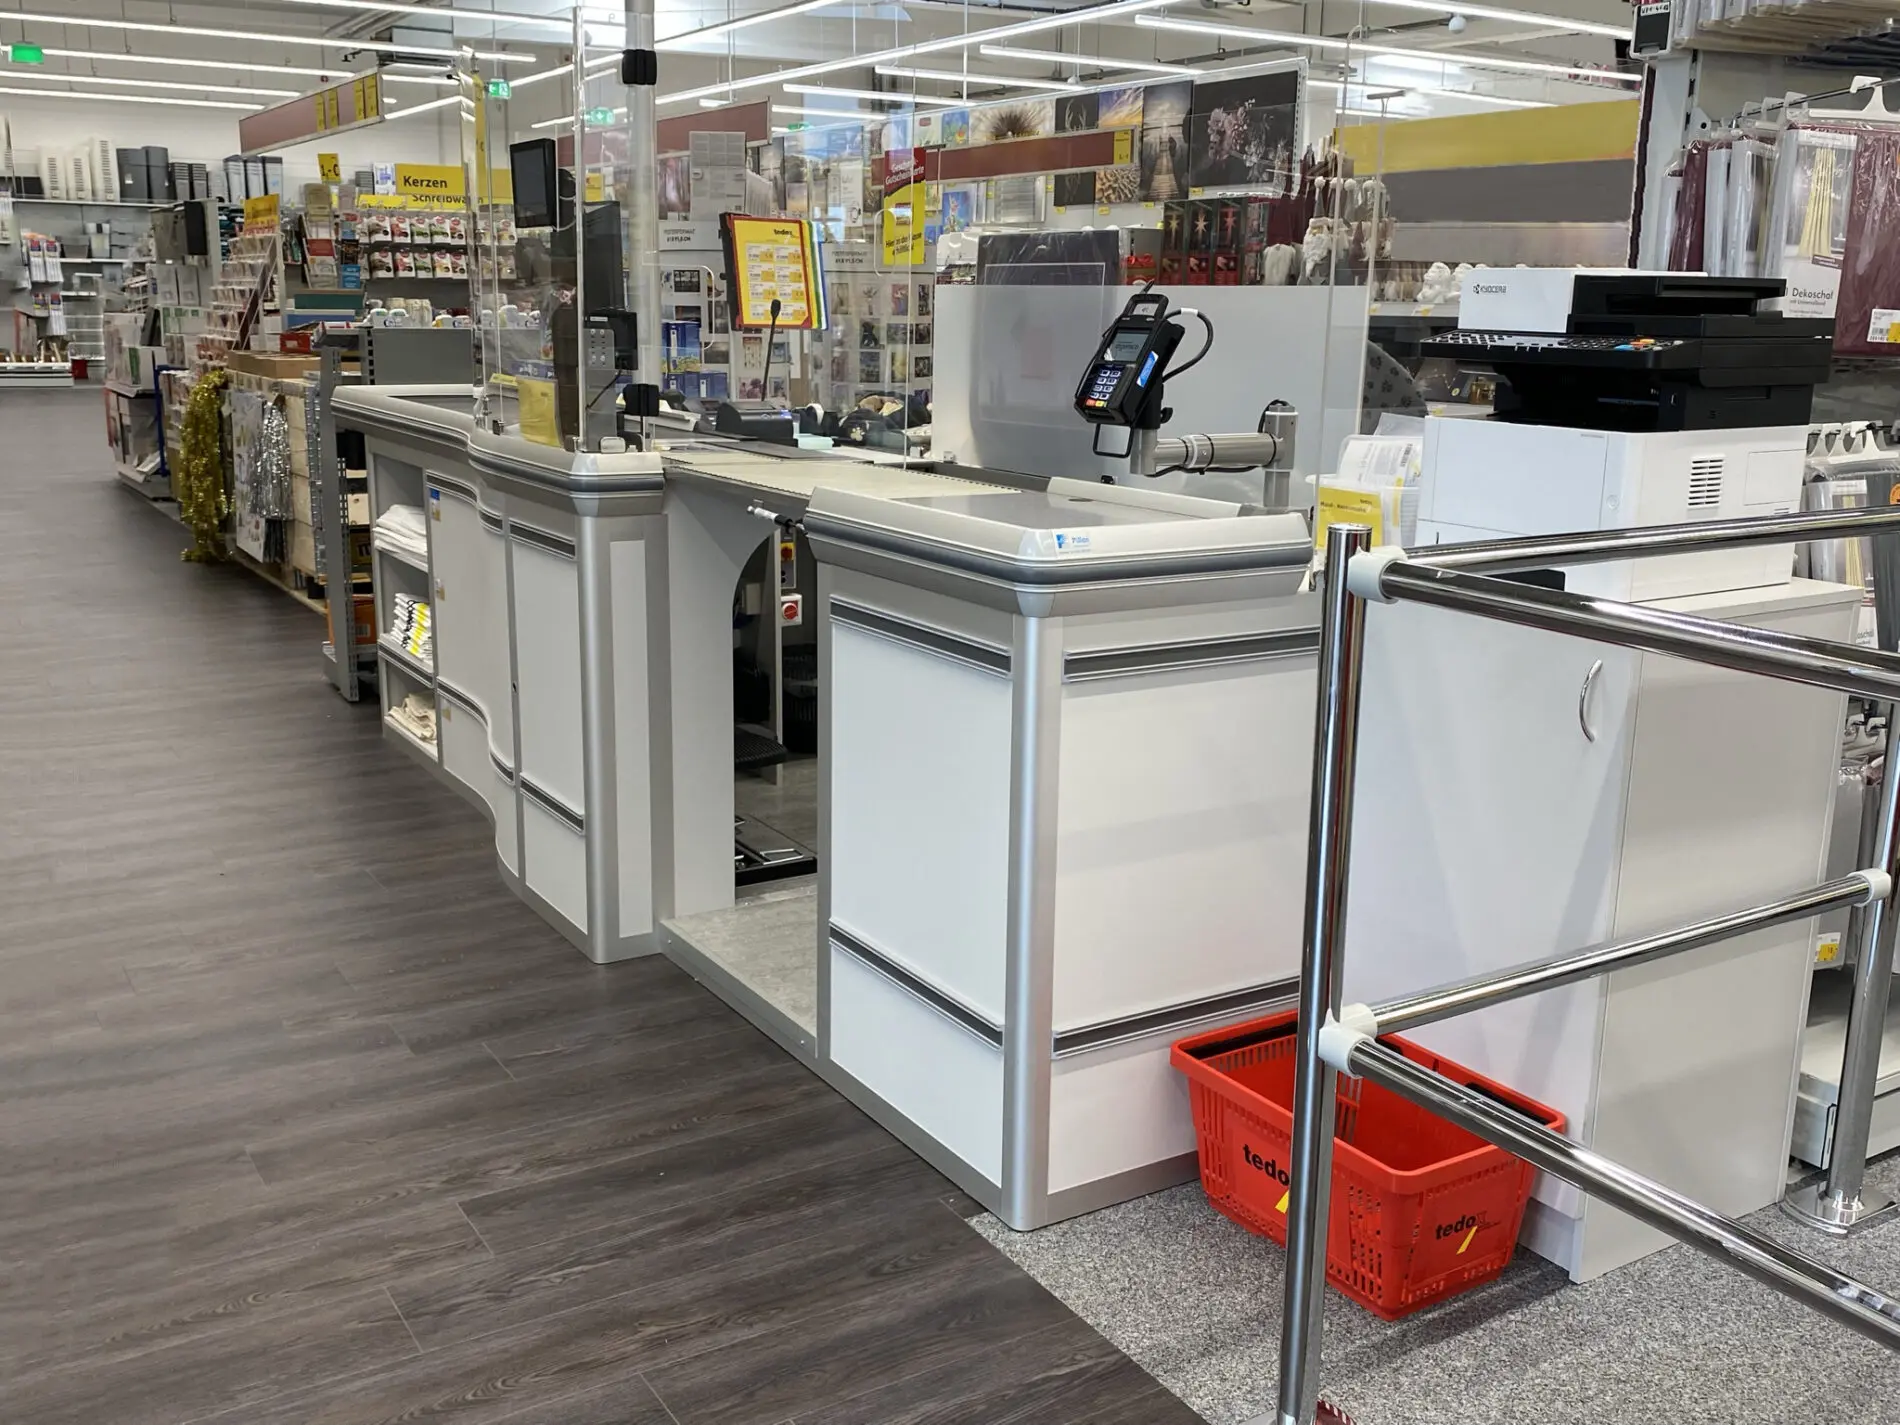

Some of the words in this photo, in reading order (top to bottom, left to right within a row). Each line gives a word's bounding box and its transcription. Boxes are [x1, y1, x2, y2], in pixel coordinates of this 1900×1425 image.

[403, 175, 448, 189] Kerzen
[412, 193, 484, 204] Schreibwan
[1480, 285, 1507, 293] KYOCERA
[1792, 287, 1834, 300] Dekoschal
[1242, 1143, 1290, 1186] tedo
